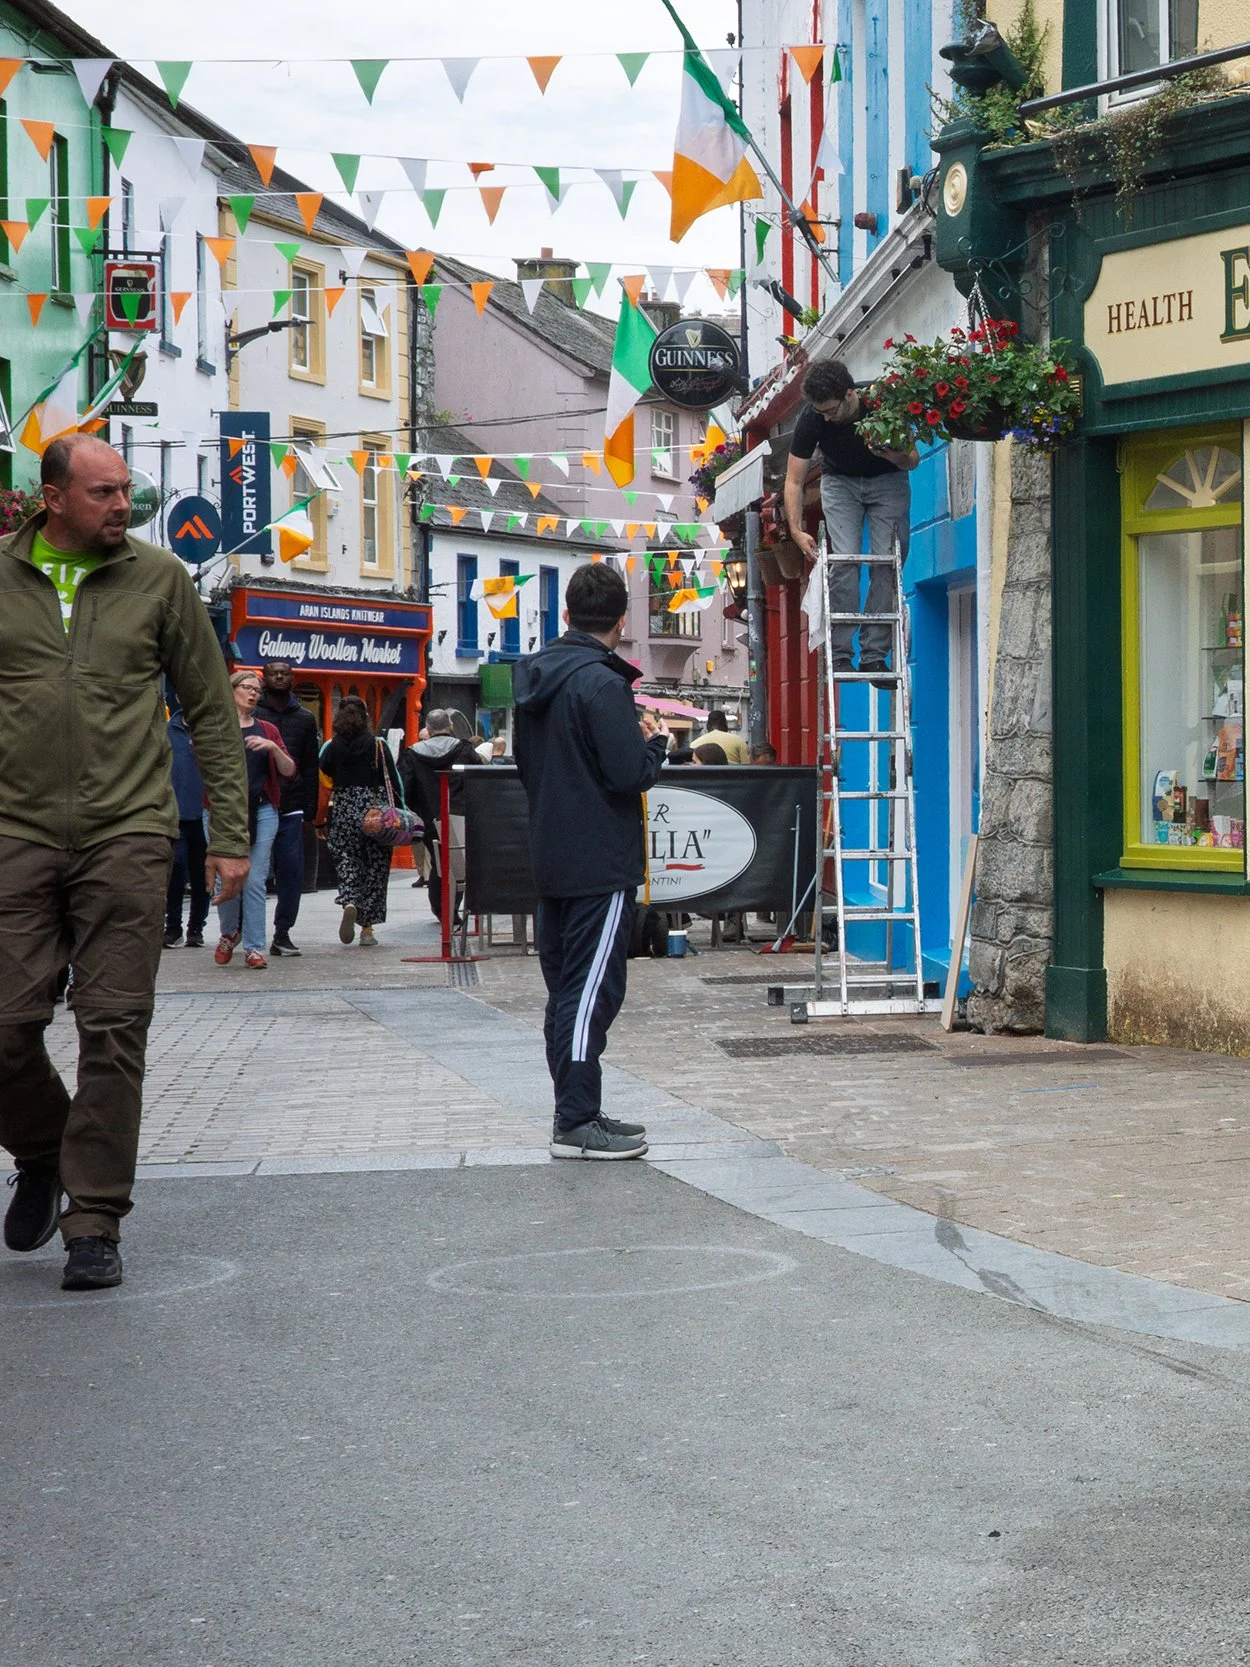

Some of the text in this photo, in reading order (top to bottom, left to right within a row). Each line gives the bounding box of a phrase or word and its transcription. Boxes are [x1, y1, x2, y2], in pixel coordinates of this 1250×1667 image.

[1107, 290, 1194, 334] HEALTH
[242, 431, 256, 534] PORTWEST
[300, 604, 385, 623] ARAN ISLANDS KNITWEAR
[258, 631, 402, 665] Galway Woollen Market
